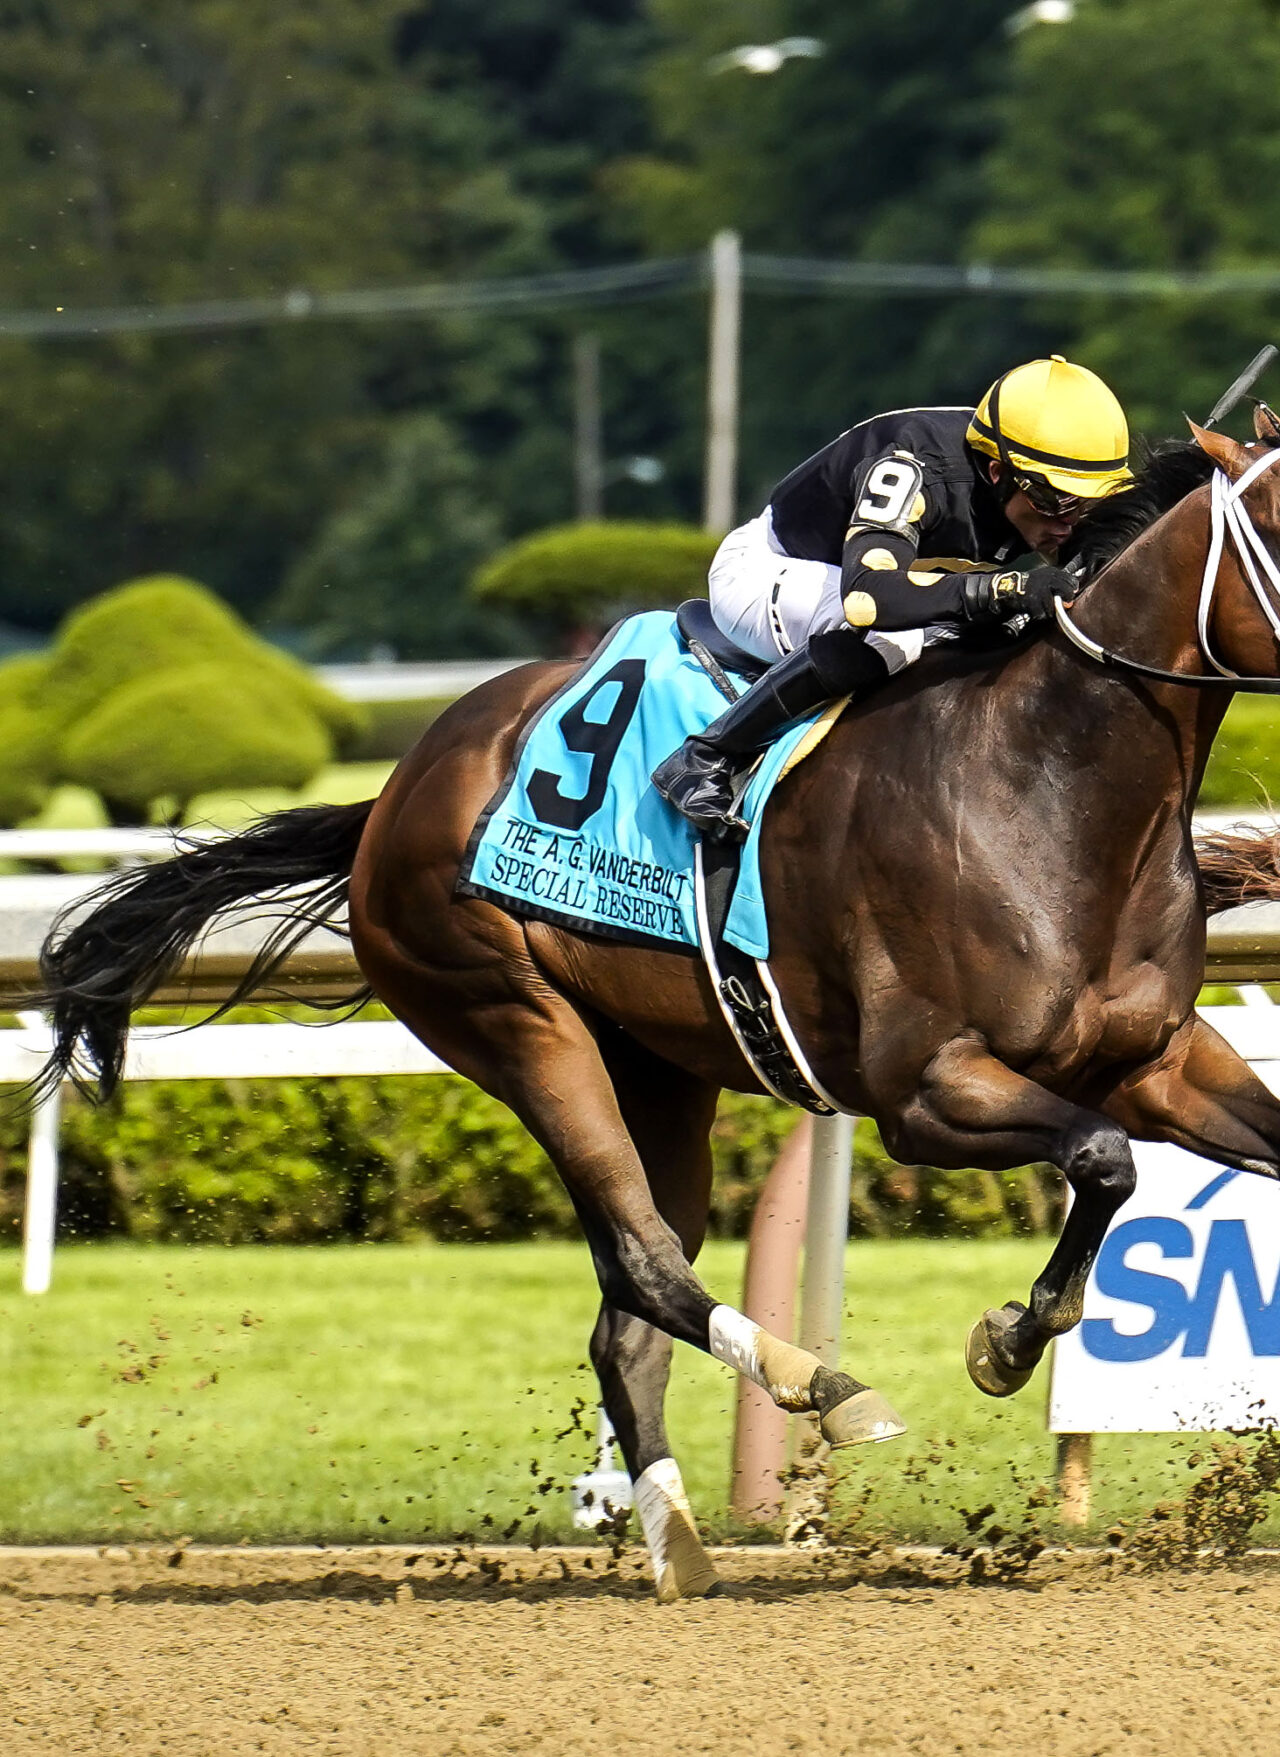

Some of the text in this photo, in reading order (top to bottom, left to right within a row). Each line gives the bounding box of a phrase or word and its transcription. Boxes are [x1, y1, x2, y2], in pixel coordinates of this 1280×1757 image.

[858, 461, 916, 522] 9
[526, 659, 646, 831] 9
[490, 854, 683, 935] SPECIAL RESERVE
[501, 819, 542, 855] THE
[589, 845, 688, 901] VANDERBILT
